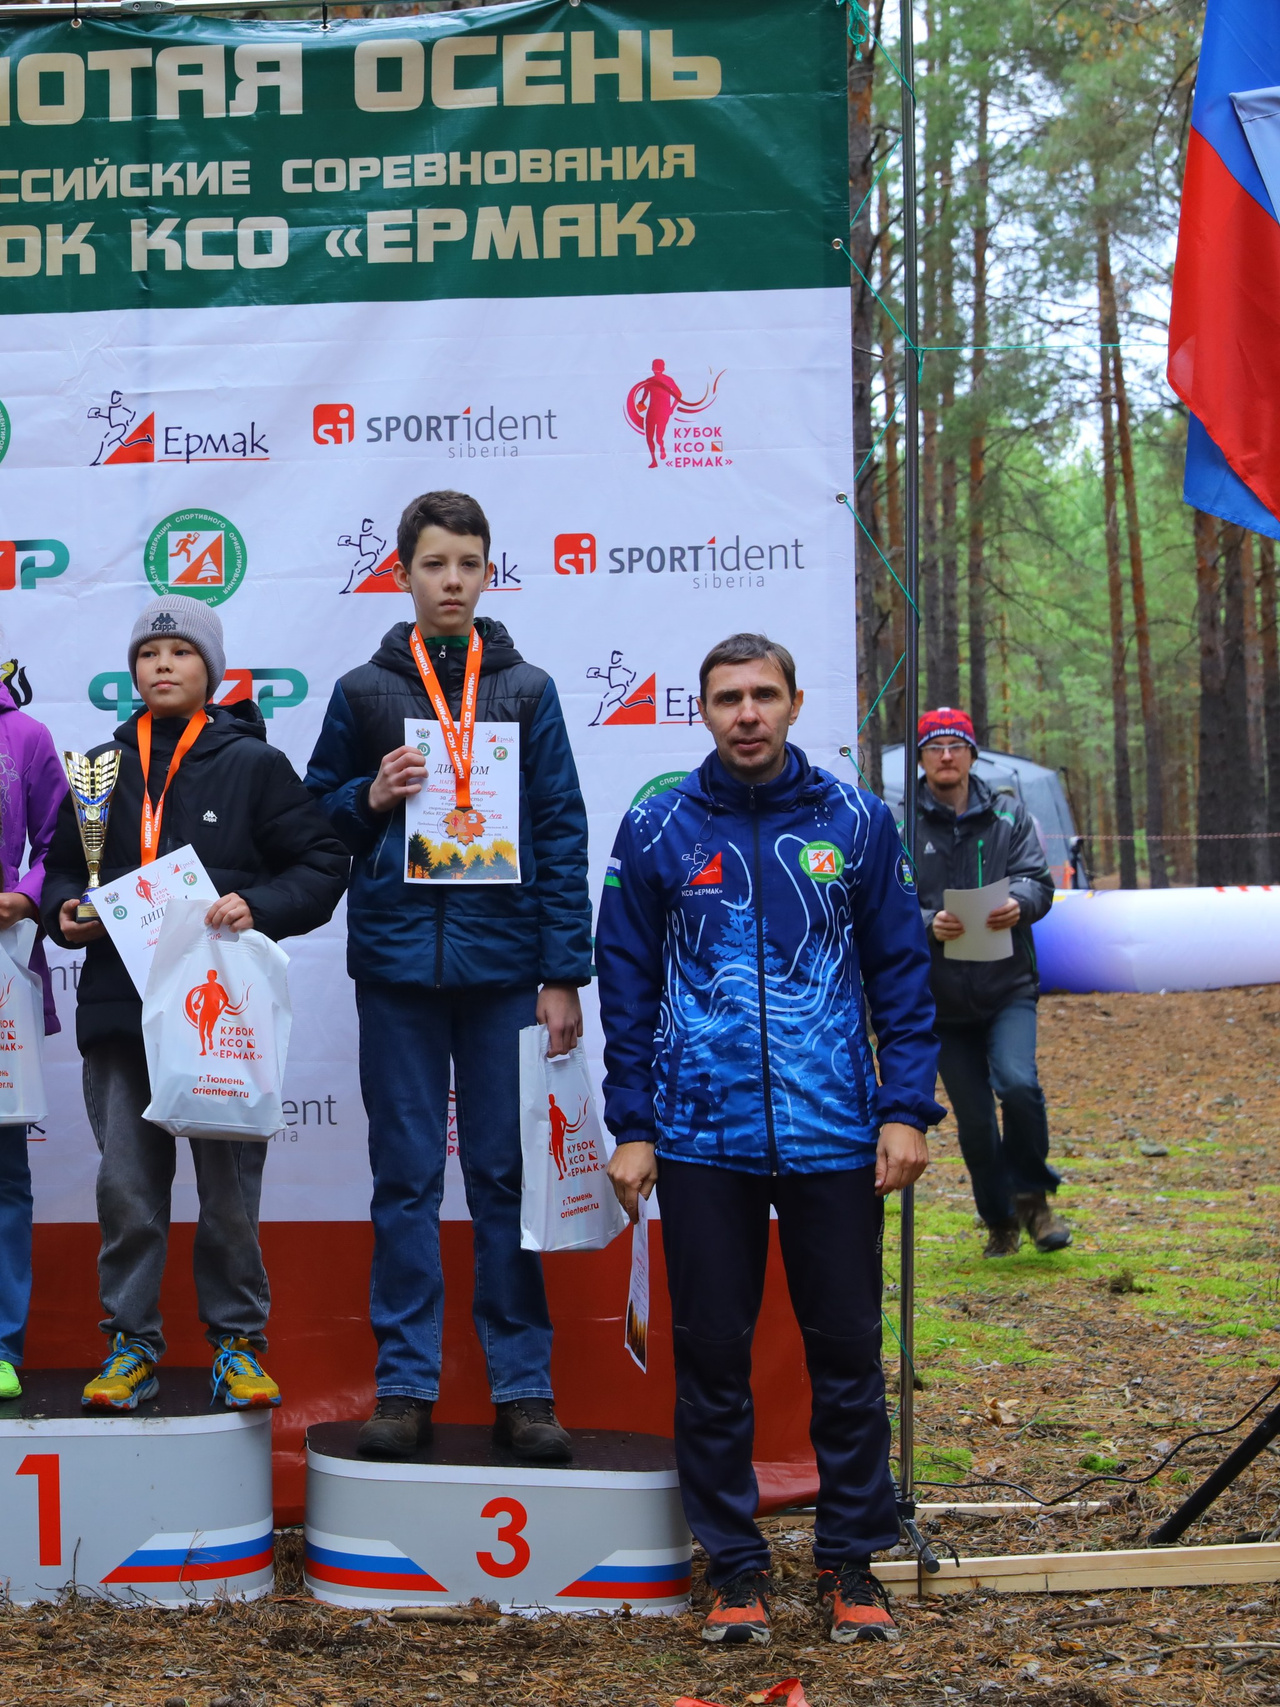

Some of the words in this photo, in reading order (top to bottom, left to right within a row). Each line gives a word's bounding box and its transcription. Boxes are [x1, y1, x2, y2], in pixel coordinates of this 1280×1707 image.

[354, 29, 723, 113] ОСЕНЬ
[282, 144, 696, 193] СОРЕВНОВАНИЯ
[131, 217, 290, 273] КСО
[325, 201, 697, 264] «ЕРМАК»
[366, 405, 558, 443] SPORTident
[673, 426, 722, 438] КУБОК
[163, 420, 269, 461] Ермак
[673, 441, 704, 453] КСО
[448, 443, 519, 459] siberia
[664, 455, 733, 468] «ЕРМАК»
[149, 523, 172, 561] ФЕДЕРАЦИЯ
[175, 513, 226, 529] СПОРТИВНОГО
[222, 532, 242, 595] ОРИЕНТИРОВАНИЯ
[609, 534, 805, 574] SPORTident
[150, 565, 169, 595] ОБЛАСТИ
[693, 572, 765, 589] siberia
[151, 623, 178, 632] Kappa
[415, 643, 430, 676] ТЮМЕНЬ
[467, 673, 475, 710] «ЕРМАК»
[435, 694, 451, 729] «ЕРМАК»
[464, 711, 472, 728] КСО
[446, 731, 457, 749] КСО
[462, 731, 470, 760] КУБОК
[435, 764, 489, 775] ДИОМ
[452, 750, 464, 779] КУБОК
[468, 813, 478, 823] 3
[144, 821, 152, 848] КУБОК
[681, 889, 693, 897] КСО
[694, 887, 723, 896] «ЕРМАК»
[140, 907, 165, 928] ДИП
[220, 1026, 255, 1037] КУБОК
[220, 1038, 243, 1048] КСО
[212, 1050, 263, 1061] «ЕРМАК»
[198, 1074, 245, 1086] г.Тюмень
[192, 1086, 249, 1098] orienteer.ru
[567, 1140, 596, 1154] КУБОК
[569, 1155, 585, 1165] КСО
[568, 1163, 606, 1178] «ЕРМАК»
[562, 1191, 593, 1206] г.Тюмень
[560, 1201, 599, 1219] orienteer.ru
[15, 1454, 61, 1566] 1
[475, 1496, 531, 1578] 3
